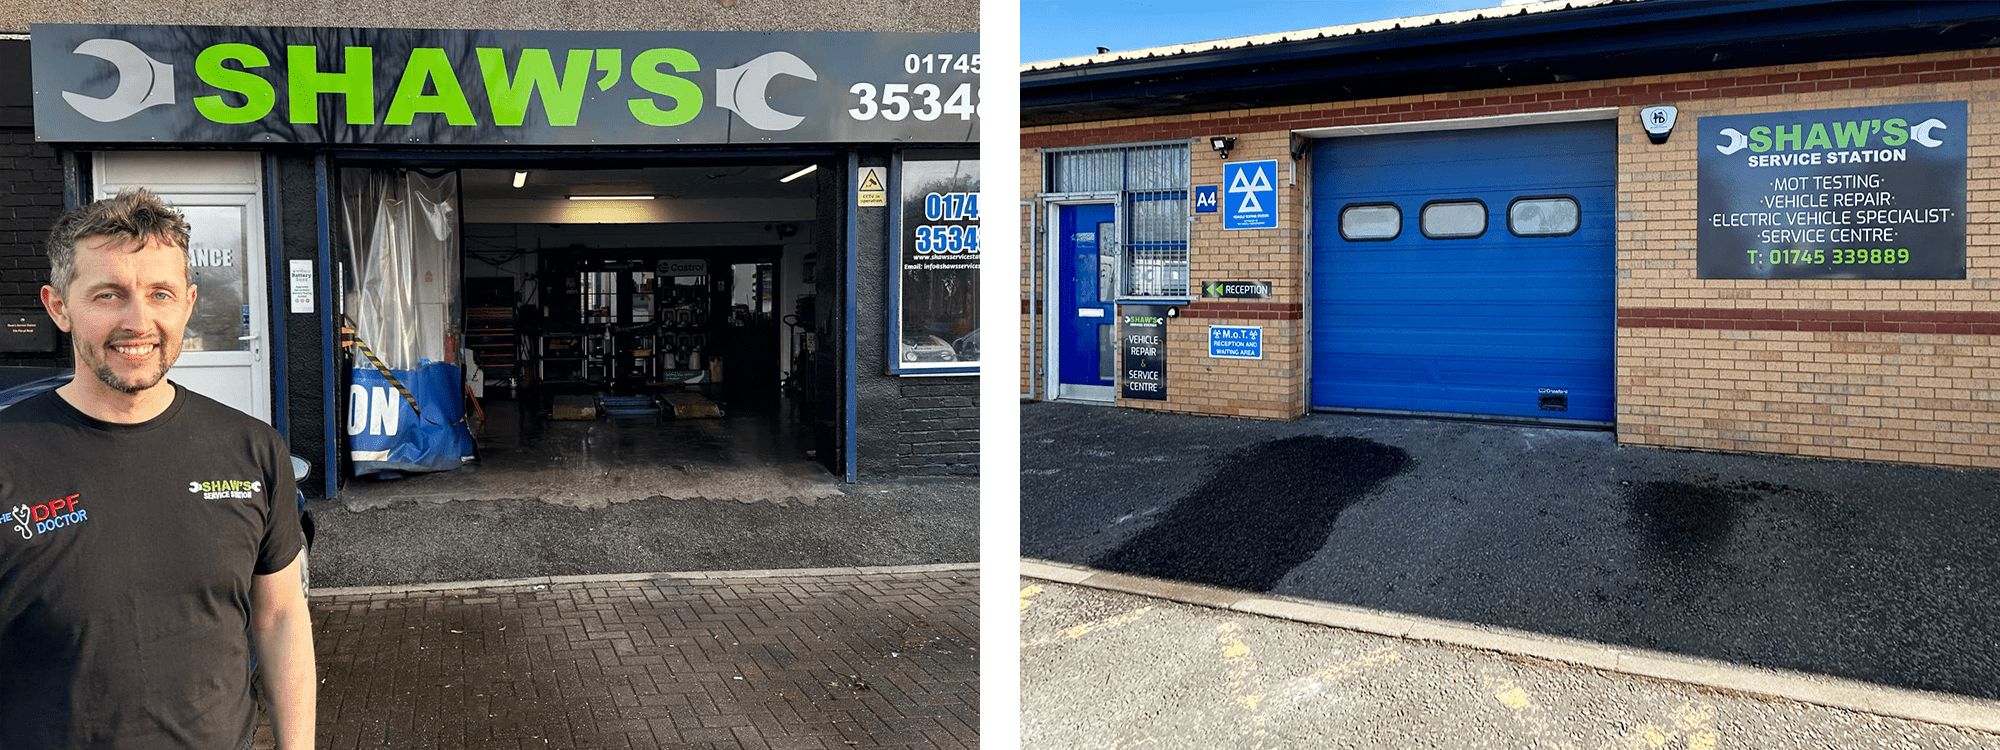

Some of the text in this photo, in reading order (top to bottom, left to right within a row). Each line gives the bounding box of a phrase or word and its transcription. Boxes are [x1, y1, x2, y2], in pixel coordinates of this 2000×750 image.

[193, 43, 704, 127] SHAW'S
[848, 82, 980, 121] 3534
[1749, 118, 1909, 153] SHAW'S
[1748, 149, 1906, 167] SERVICE STATION
[925, 192, 980, 221] 0174
[1197, 192, 1216, 207] A4
[1786, 210, 1851, 226] VEHICLE
[915, 225, 980, 254] 3534
[1747, 248, 1910, 265] T: 01745 339889
[671, 263, 704, 272] Castrol
[1225, 284, 1268, 294] RECEPTION
[1128, 335, 1159, 345] VEHICLE
[1222, 329, 1248, 339] M.o.T.
[1130, 346, 1157, 356] REPAIR
[1140, 359, 1146, 368] &
[1128, 369, 1159, 380] SERVICE
[1129, 381, 1158, 392] CENTRE
[202, 480, 251, 492] SHAW'S
[31, 493, 80, 522] DPF
[36, 509, 88, 534] DOCTOR
